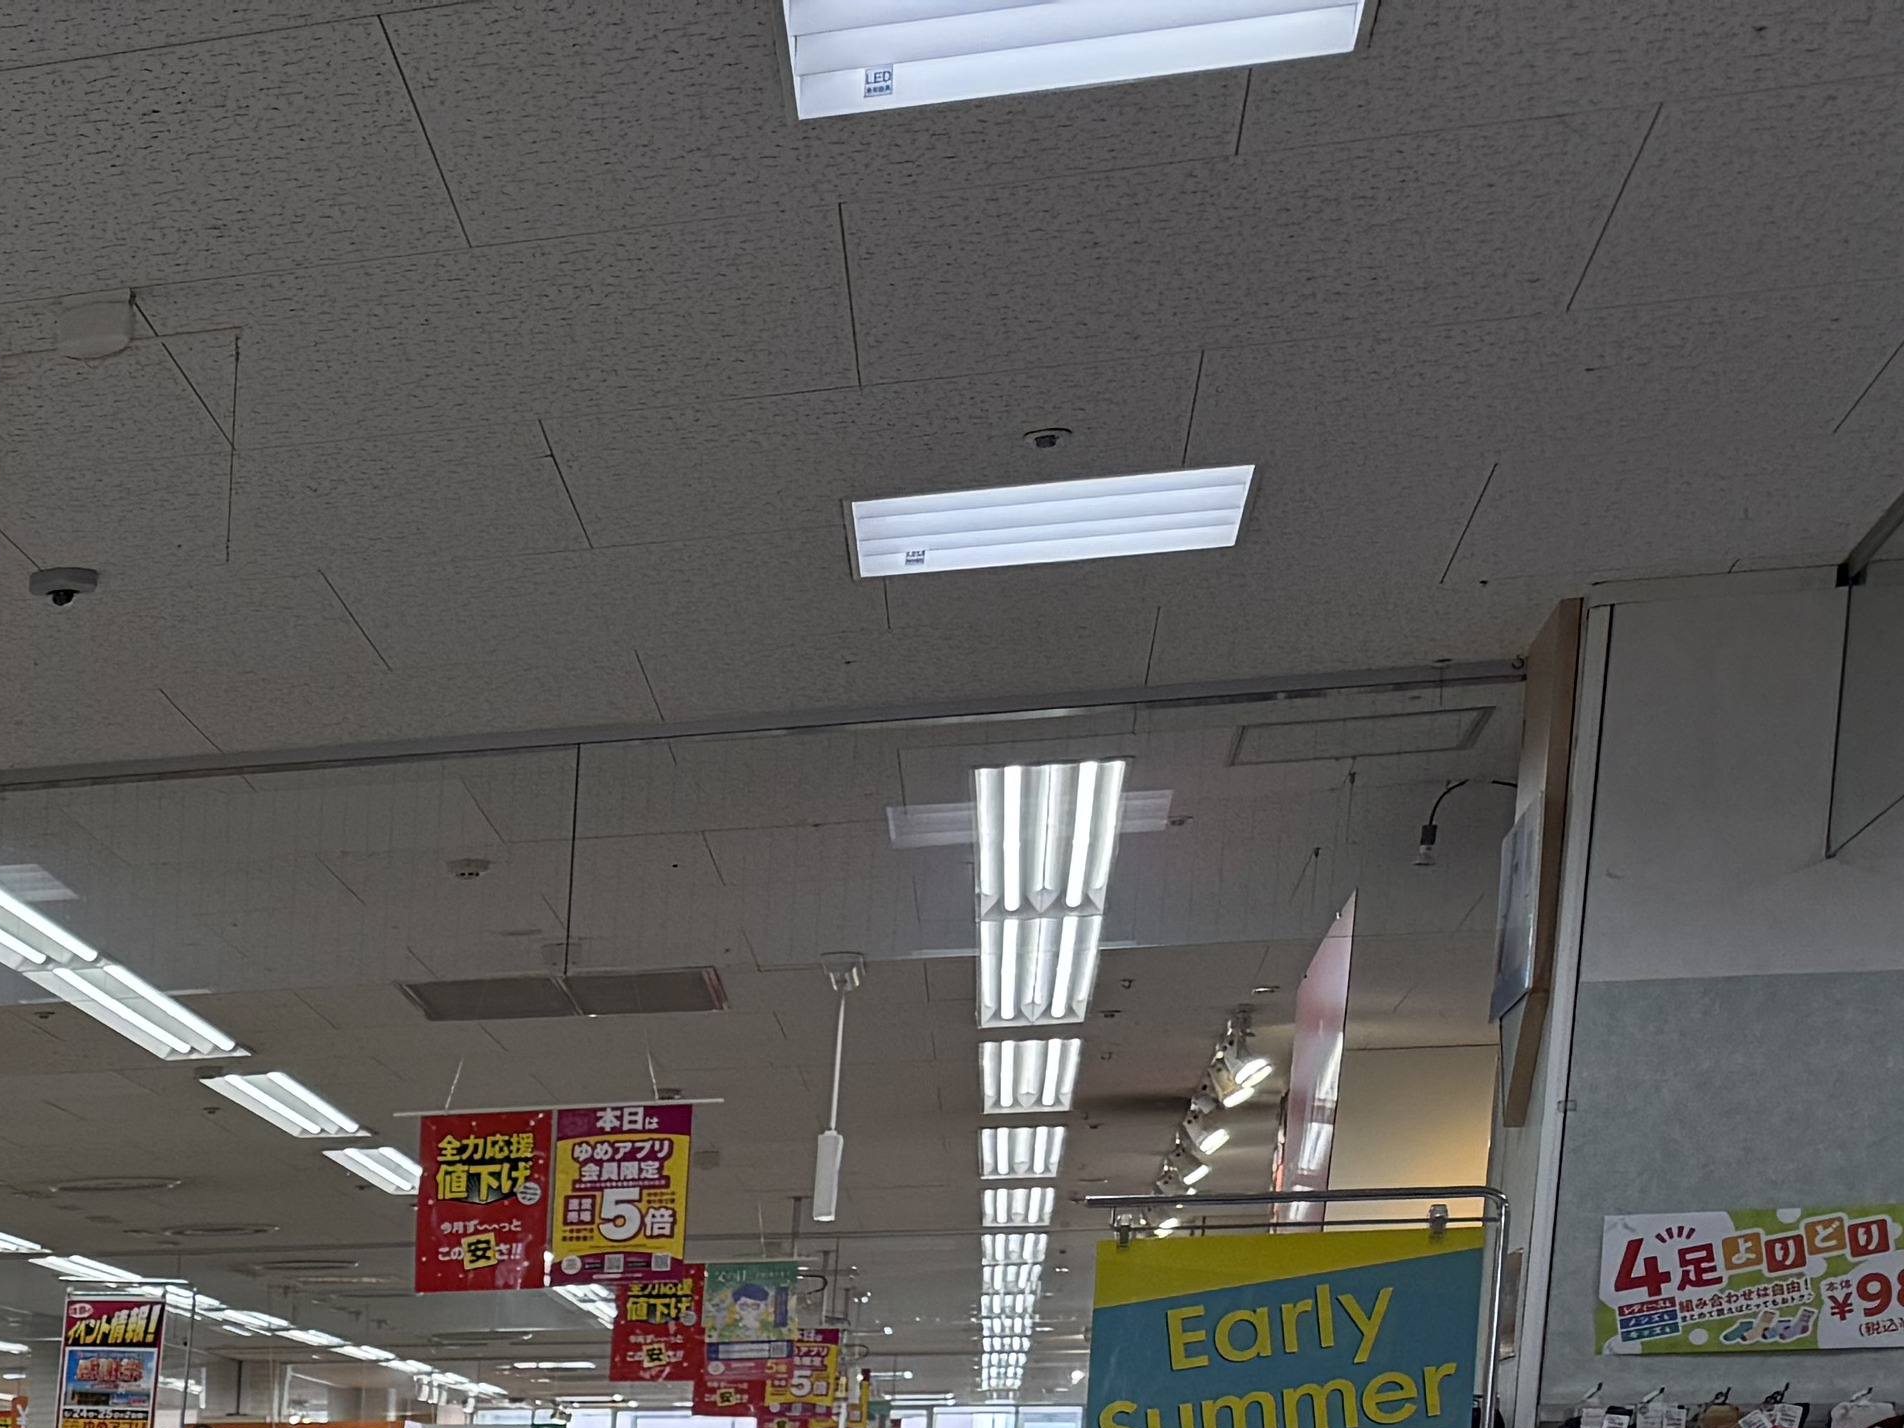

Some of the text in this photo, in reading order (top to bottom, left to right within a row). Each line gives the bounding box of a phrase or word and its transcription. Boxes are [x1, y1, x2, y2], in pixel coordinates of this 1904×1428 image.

[595, 1107, 659, 1132] 本日は
[437, 1133, 534, 1161] 全力応援
[573, 1139, 671, 1162] ゆめアプリ
[436, 1161, 533, 1200] 値下げ
[580, 1161, 660, 1182] 会員限定
[599, 1187, 675, 1242] 5倍
[1679, 1278, 1811, 1313] 組み合わせは自由!
[1825, 1279, 1853, 1291] 本体
[626, 1297, 693, 1322] 値下げ
[68, 1304, 163, 1345] イベント情報!
[1166, 1283, 1394, 1374] Early
